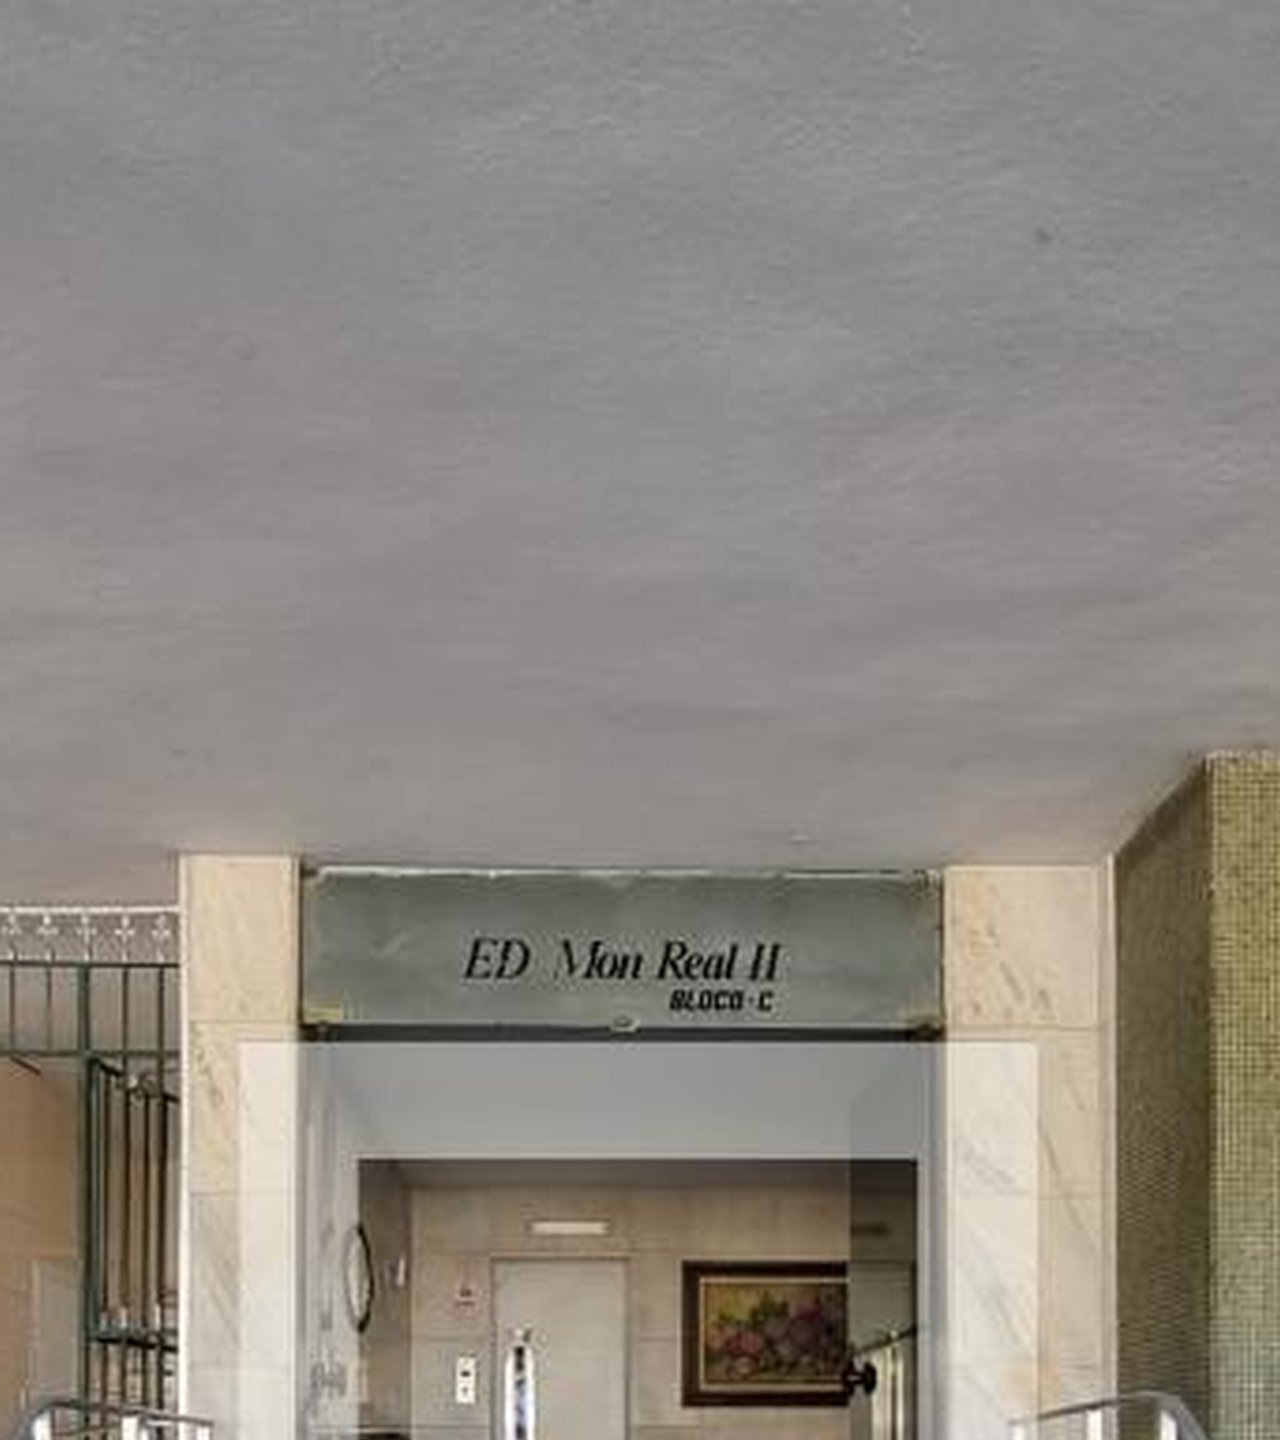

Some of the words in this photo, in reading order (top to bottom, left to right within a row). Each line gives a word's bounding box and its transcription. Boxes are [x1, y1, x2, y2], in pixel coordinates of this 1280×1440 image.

[465, 937, 531, 979] ED
[657, 940, 739, 980] Real
[670, 989, 745, 1012] BLOCO
